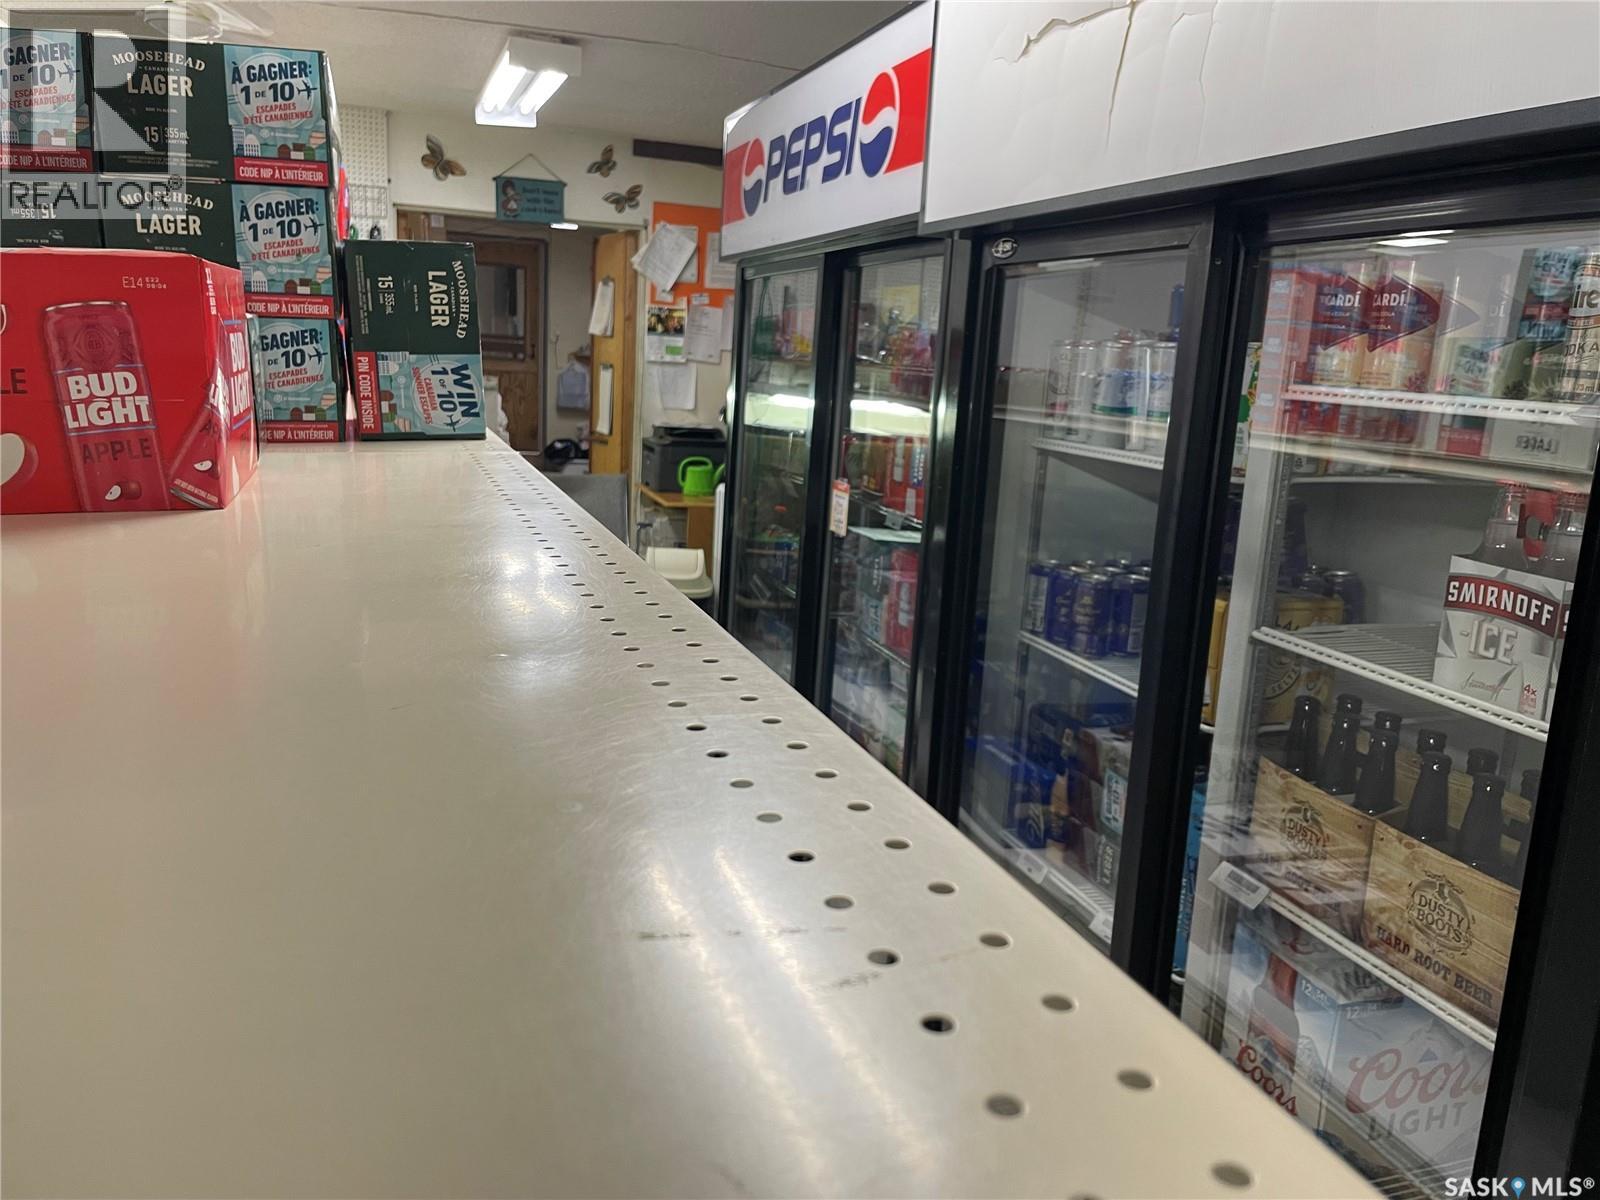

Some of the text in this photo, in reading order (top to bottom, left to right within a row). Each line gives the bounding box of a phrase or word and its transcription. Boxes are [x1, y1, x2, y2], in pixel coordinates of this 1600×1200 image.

[112, 51, 206, 72] MOOSEHEAD
[231, 60, 312, 85] À GAGNER:
[12, 74, 25, 82] DE
[28, 64, 56, 86] 10
[126, 73, 194, 98] LAGER
[14, 86, 58, 98] ESCAPADES
[240, 81, 295, 105] 1 DE 10
[256, 102, 297, 114] ESCAPADES
[264, 111, 314, 123] CANADIENNES
[144, 126, 160, 143] 15
[20, 155, 33, 167] NIP
[35, 153, 41, 167] À
[42, 154, 88, 169] L'INTÉRIEUR
[763, 96, 863, 204] PEPSI
[239, 165, 324, 181] CODE NIP À L'INTÉRIEUR
[121, 190, 214, 210] MOOSEHEAD
[240, 197, 320, 222] À GAGNER:
[135, 213, 202, 236] LAGER
[248, 223, 259, 242] 1
[276, 218, 302, 239] 10
[263, 238, 304, 250] ESCAPADES
[272, 246, 320, 258] CANADIENNES
[122, 276, 143, 289] E14
[378, 275, 394, 289] 15
[247, 299, 330, 315] CODE NIP À L'INTÉRIEUR
[427, 270, 450, 327] LAGER
[451, 260, 470, 339] MOOSEHEAD
[260, 328, 323, 352] GAGNER:
[267, 348, 306, 369] DE 10
[66, 371, 138, 400] BUD
[269, 368, 308, 380] ESCAPADES
[277, 374, 324, 388] CANADIENNES
[357, 356, 375, 430] PIN CODE INSIDE
[431, 367, 458, 412] 1 OF 10
[450, 363, 481, 418] WIN
[64, 396, 152, 429] LIGHT
[273, 430, 286, 440] NIP
[287, 428, 293, 440] À
[293, 429, 334, 441] L'INTÉRIEUR
[83, 438, 153, 465] APPLE
[1448, 581, 1554, 627] SMIRNOFF
[1468, 615, 1518, 665] ICE
[1418, 894, 1465, 928] DUSTY
[1416, 908, 1463, 943] BOOTS
[1376, 925, 1411, 955] HARD
[1413, 949, 1451, 982] ROOT
[1453, 972, 1493, 1008] BEER
[1236, 1038, 1297, 1117] Coors
[1368, 1102, 1468, 1141] LIGHT
